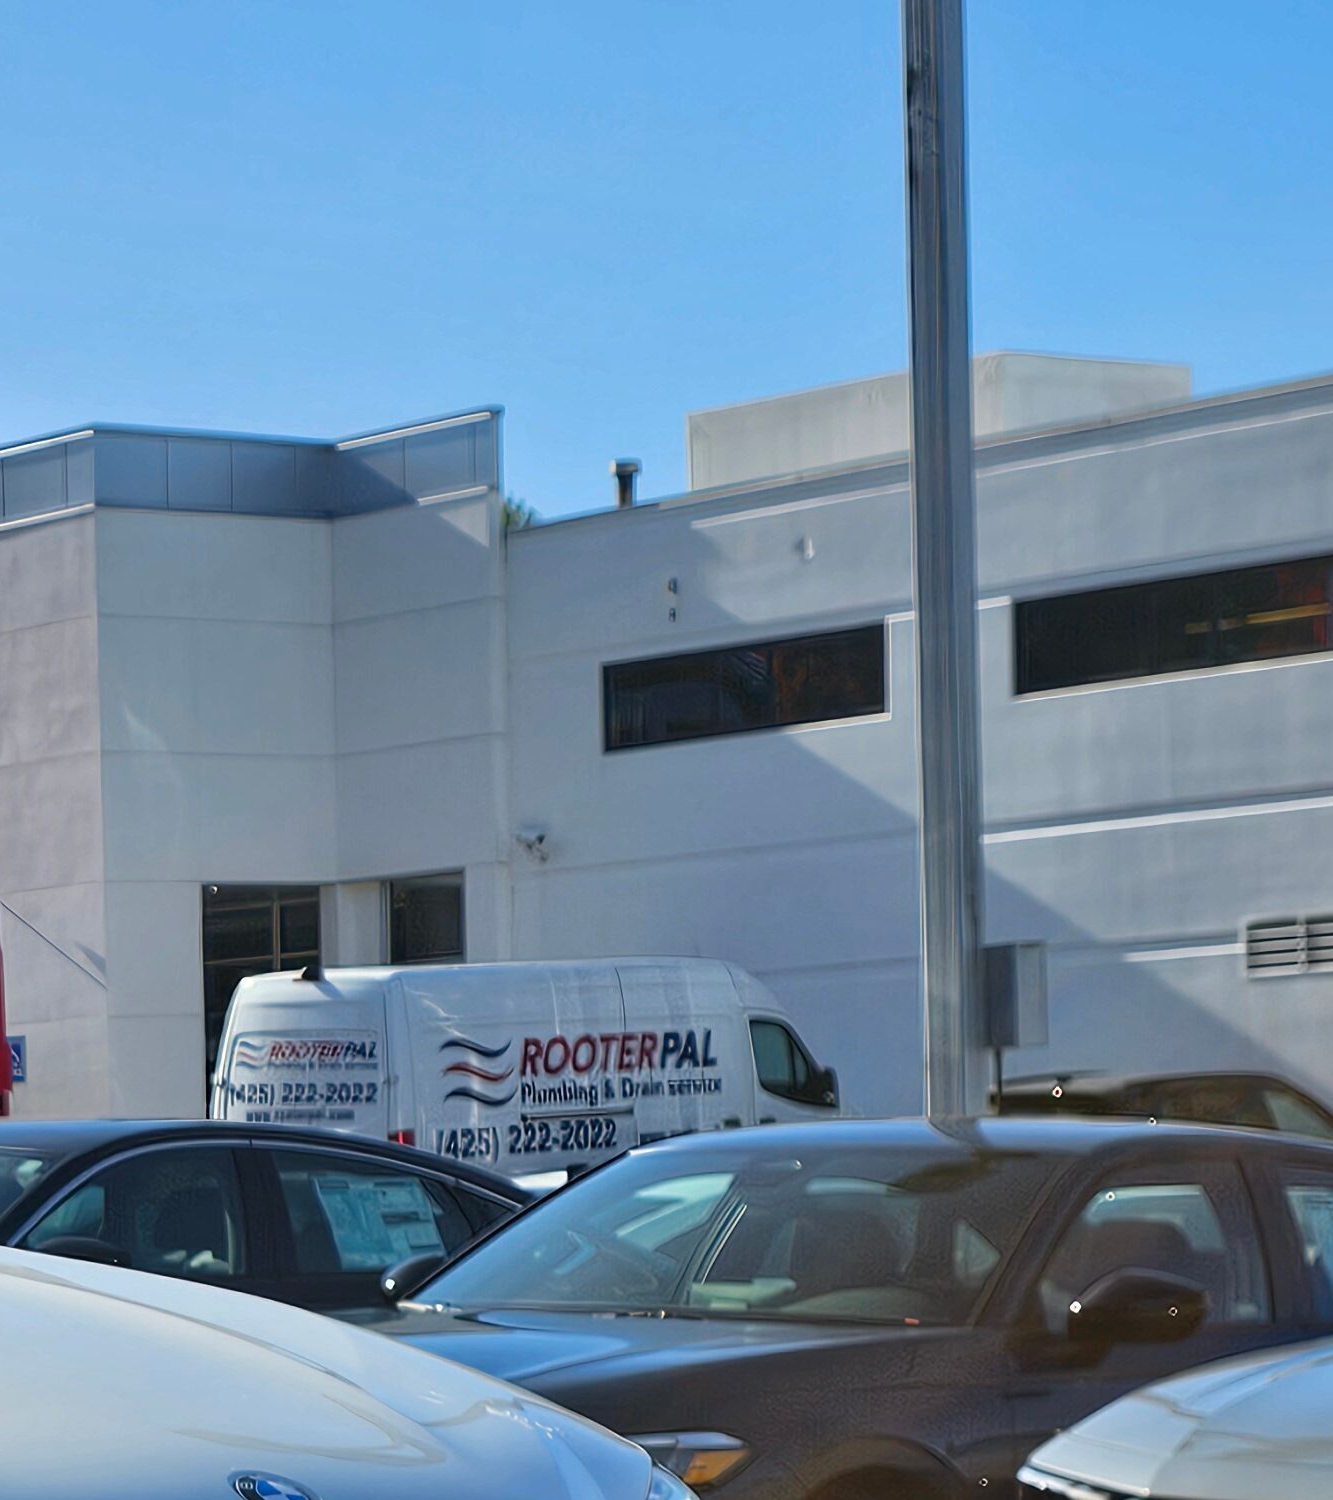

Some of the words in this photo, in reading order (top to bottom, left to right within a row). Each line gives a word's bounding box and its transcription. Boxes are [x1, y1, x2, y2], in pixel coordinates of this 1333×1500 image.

[520, 1028, 718, 1077] ROOTERPAL
[230, 1083, 275, 1106] (425)
[282, 1082, 378, 1104] 222-2022
[521, 1080, 599, 1105] Plumbing
[604, 1081, 615, 1098] &
[622, 1077, 665, 1097] Drain
[437, 1126, 498, 1163] (425)
[508, 1118, 617, 1154] 222-2022
